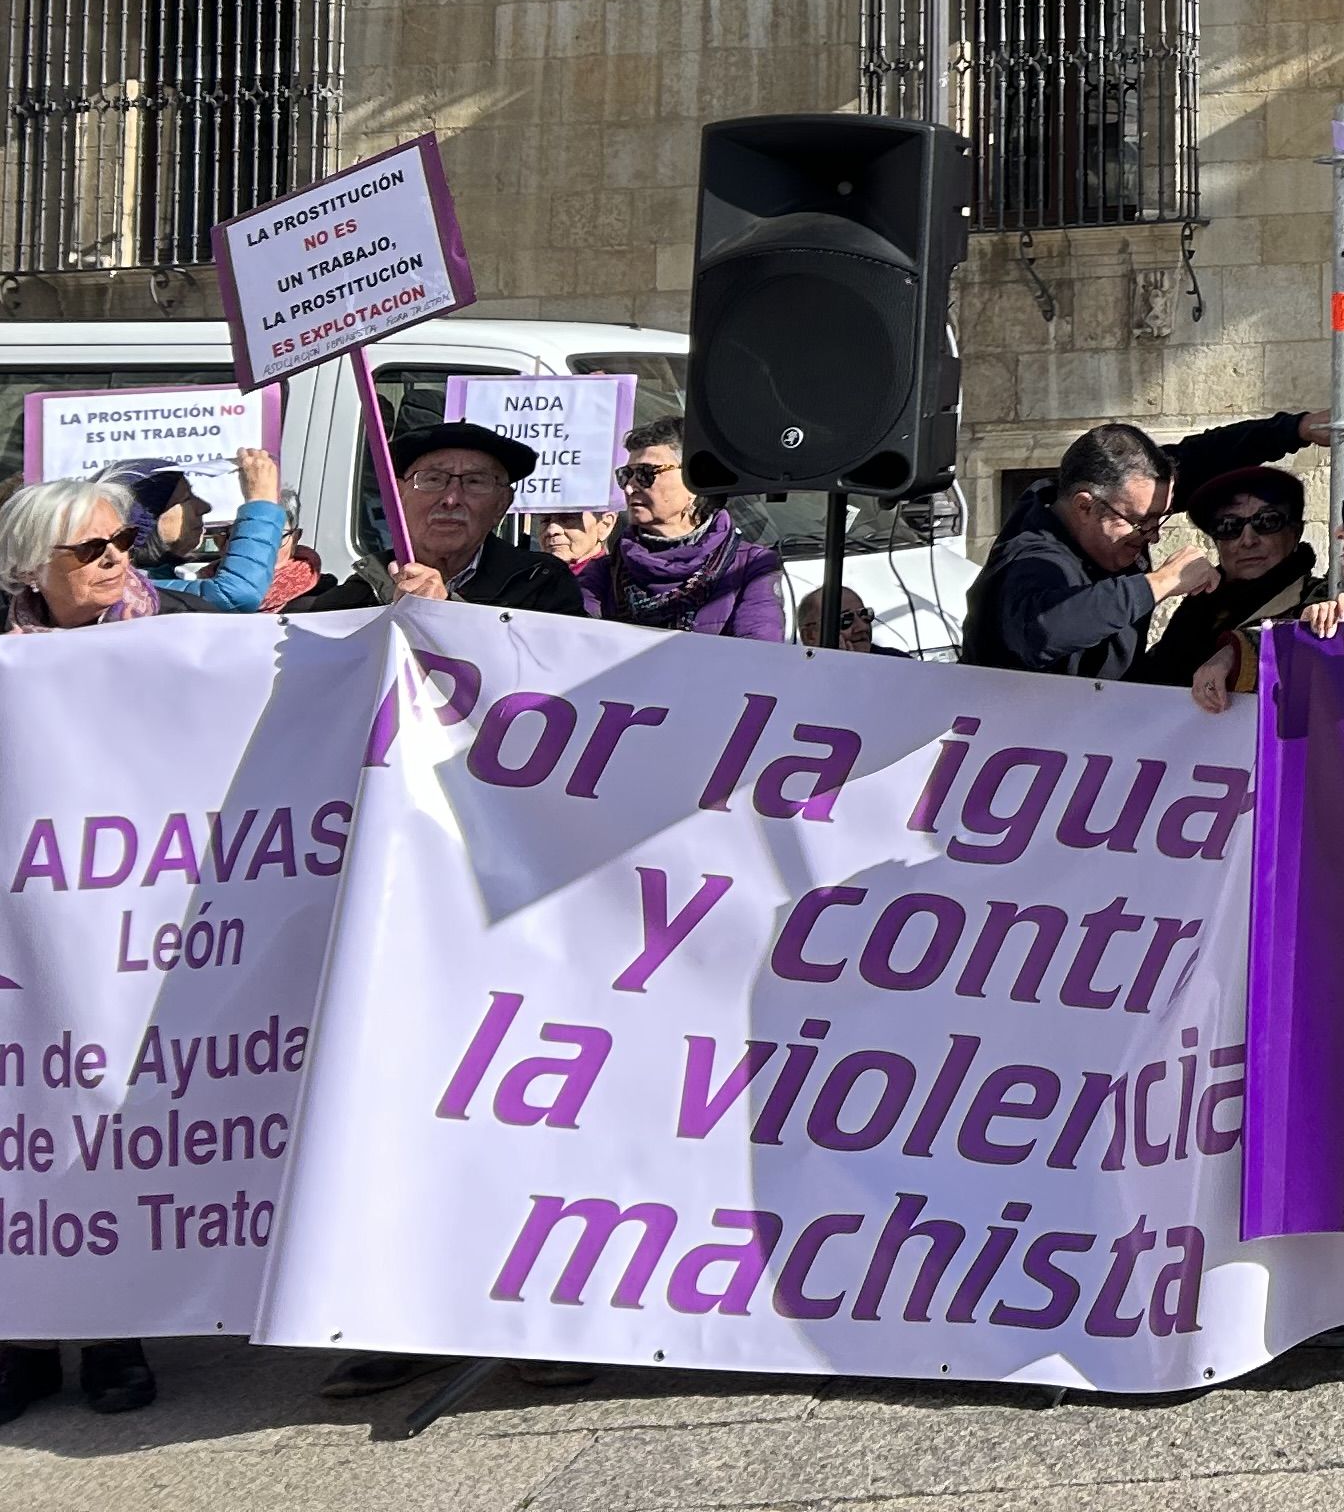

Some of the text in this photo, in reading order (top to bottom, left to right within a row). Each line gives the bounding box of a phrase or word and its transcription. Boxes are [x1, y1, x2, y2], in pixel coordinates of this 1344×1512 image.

[247, 169, 405, 247] LA PROSTITUCIÓN
[303, 218, 358, 251] NO ES
[262, 254, 423, 331] LA PROSTITUCIÓN
[277, 236, 397, 293] UN TRABAJO,
[272, 336, 295, 359] ES
[60, 403, 245, 425] LA PROSTITUCIÓN NO
[495, 423, 569, 441] DIJISTE,
[505, 396, 563, 411] NADA
[86, 425, 221, 443] ES UN TRABAJO
[82, 460, 98, 470] LA
[361, 648, 669, 799] Por
[698, 692, 862, 823] la
[10, 800, 354, 893] ADAVAS
[117, 901, 245, 973] León
[612, 866, 1203, 1014] y contr
[42, 1030, 107, 1089] de
[126, 1015, 310, 1099] Ayuda
[435, 991, 1246, 1171] la violencia
[0, 1113, 54, 1173] de
[0, 1198, 118, 1257] alos
[489, 1192, 1203, 1338] machista
